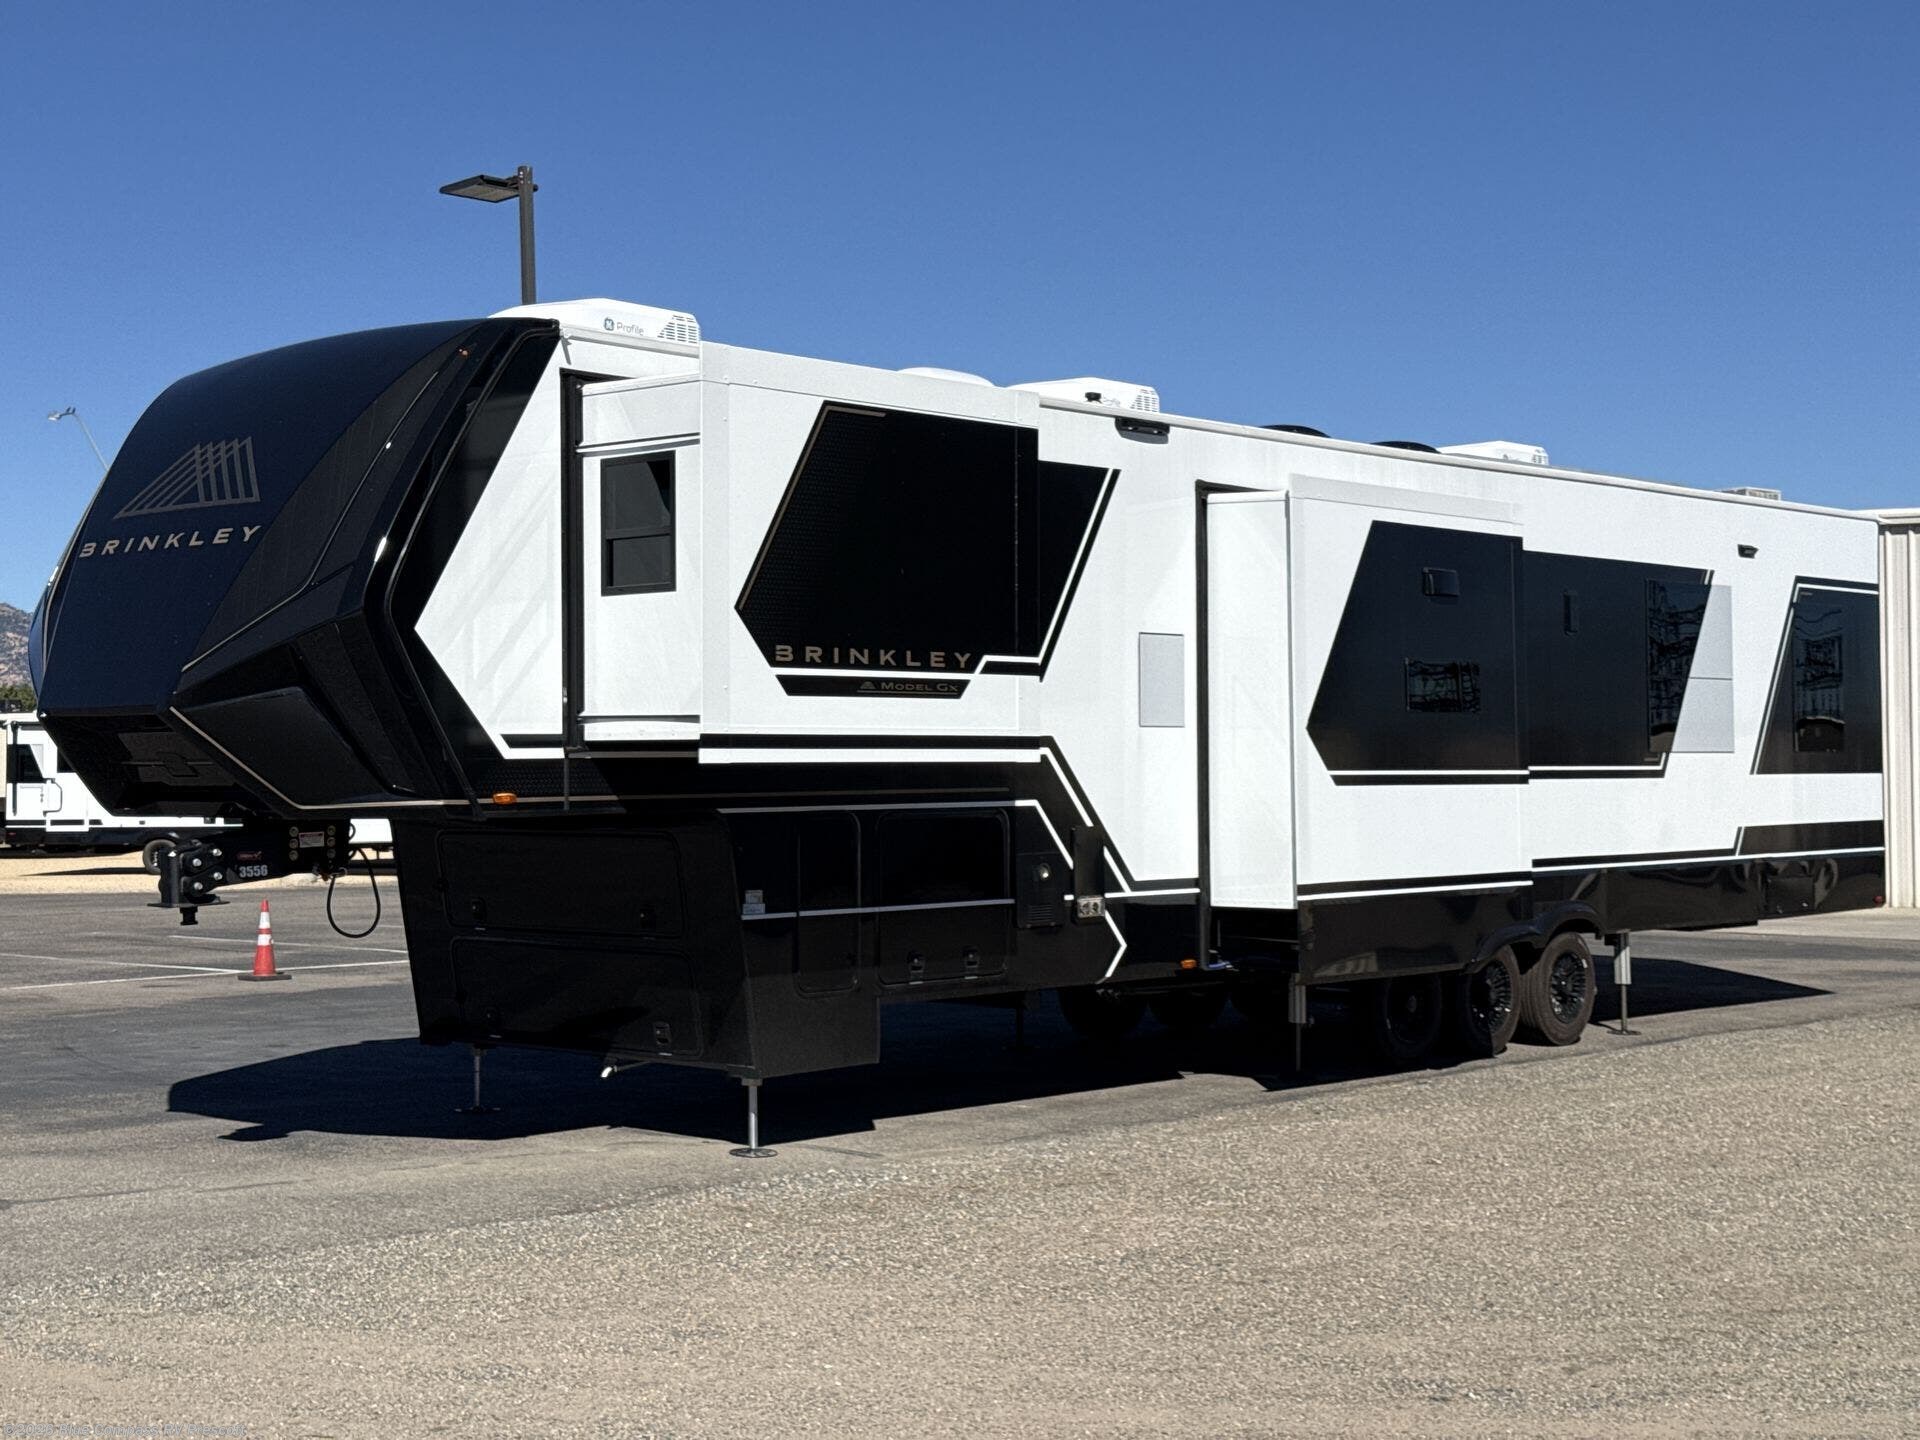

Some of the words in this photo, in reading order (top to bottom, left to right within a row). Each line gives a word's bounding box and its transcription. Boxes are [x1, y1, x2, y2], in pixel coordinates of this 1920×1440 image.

[616, 321, 644, 336] Profile
[79, 525, 261, 558] BRINKLEY
[775, 645, 971, 668] BRINKLEY
